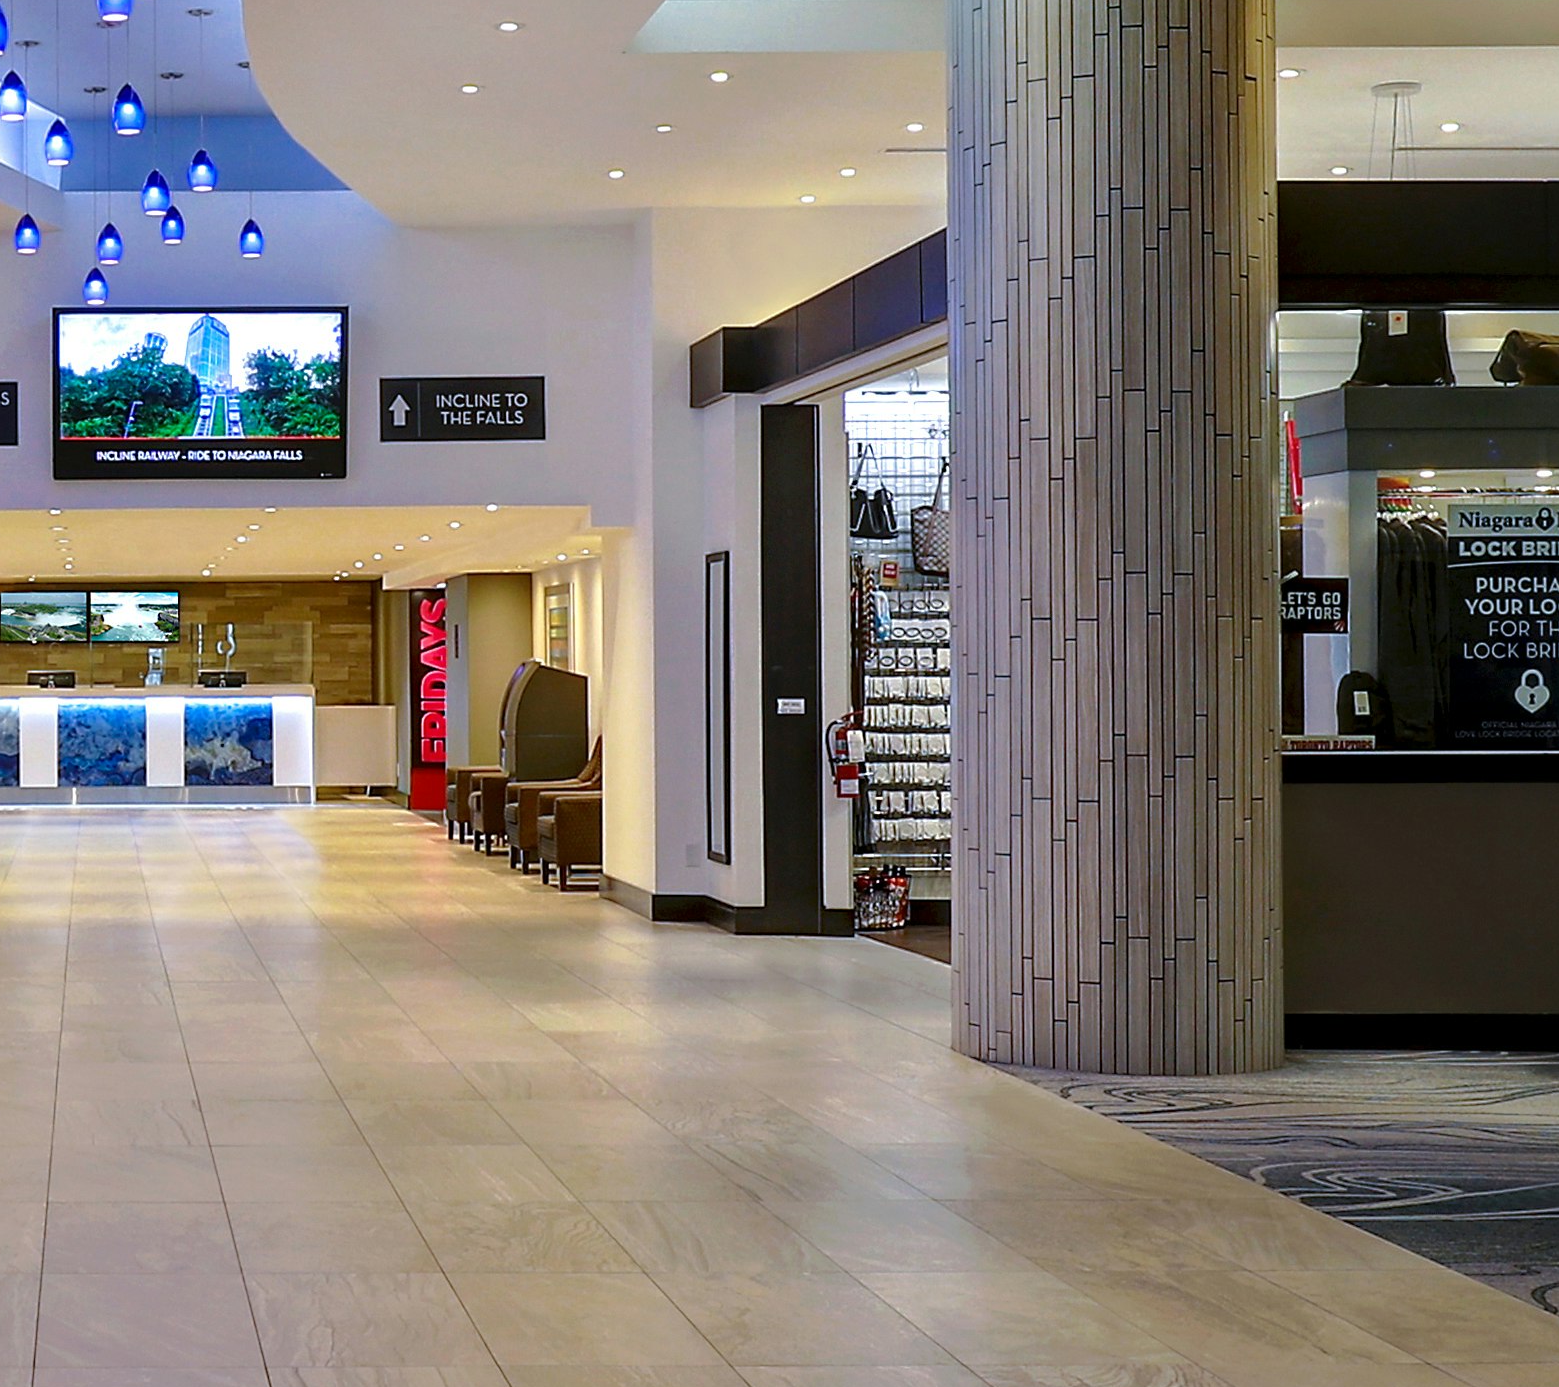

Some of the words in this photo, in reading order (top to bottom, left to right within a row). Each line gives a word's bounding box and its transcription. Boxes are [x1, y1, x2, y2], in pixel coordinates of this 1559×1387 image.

[435, 393, 501, 408] INCLINE
[505, 393, 528, 407] TO
[441, 411, 472, 425] THE
[476, 411, 524, 424] FALLS
[97, 450, 136, 461] INCLINE
[137, 450, 180, 461] RAILWAY
[187, 450, 210, 461] RIDE
[212, 450, 226, 460] TO
[227, 450, 272, 461] NIAGARA
[273, 450, 302, 460] FALLS
[1458, 512, 1533, 532] Niagara
[1458, 541, 1517, 556] LOCK
[1282, 591, 1316, 605] ET'S
[1322, 591, 1341, 605] GO
[1281, 607, 1342, 620] RAPTORS
[1465, 599, 1523, 615] YOUR
[1489, 620, 1530, 636] FOR
[1463, 642, 1519, 659] LOCK
[420, 598, 447, 763] FRIDAYS
[1478, 730, 1501, 738] LOCK
